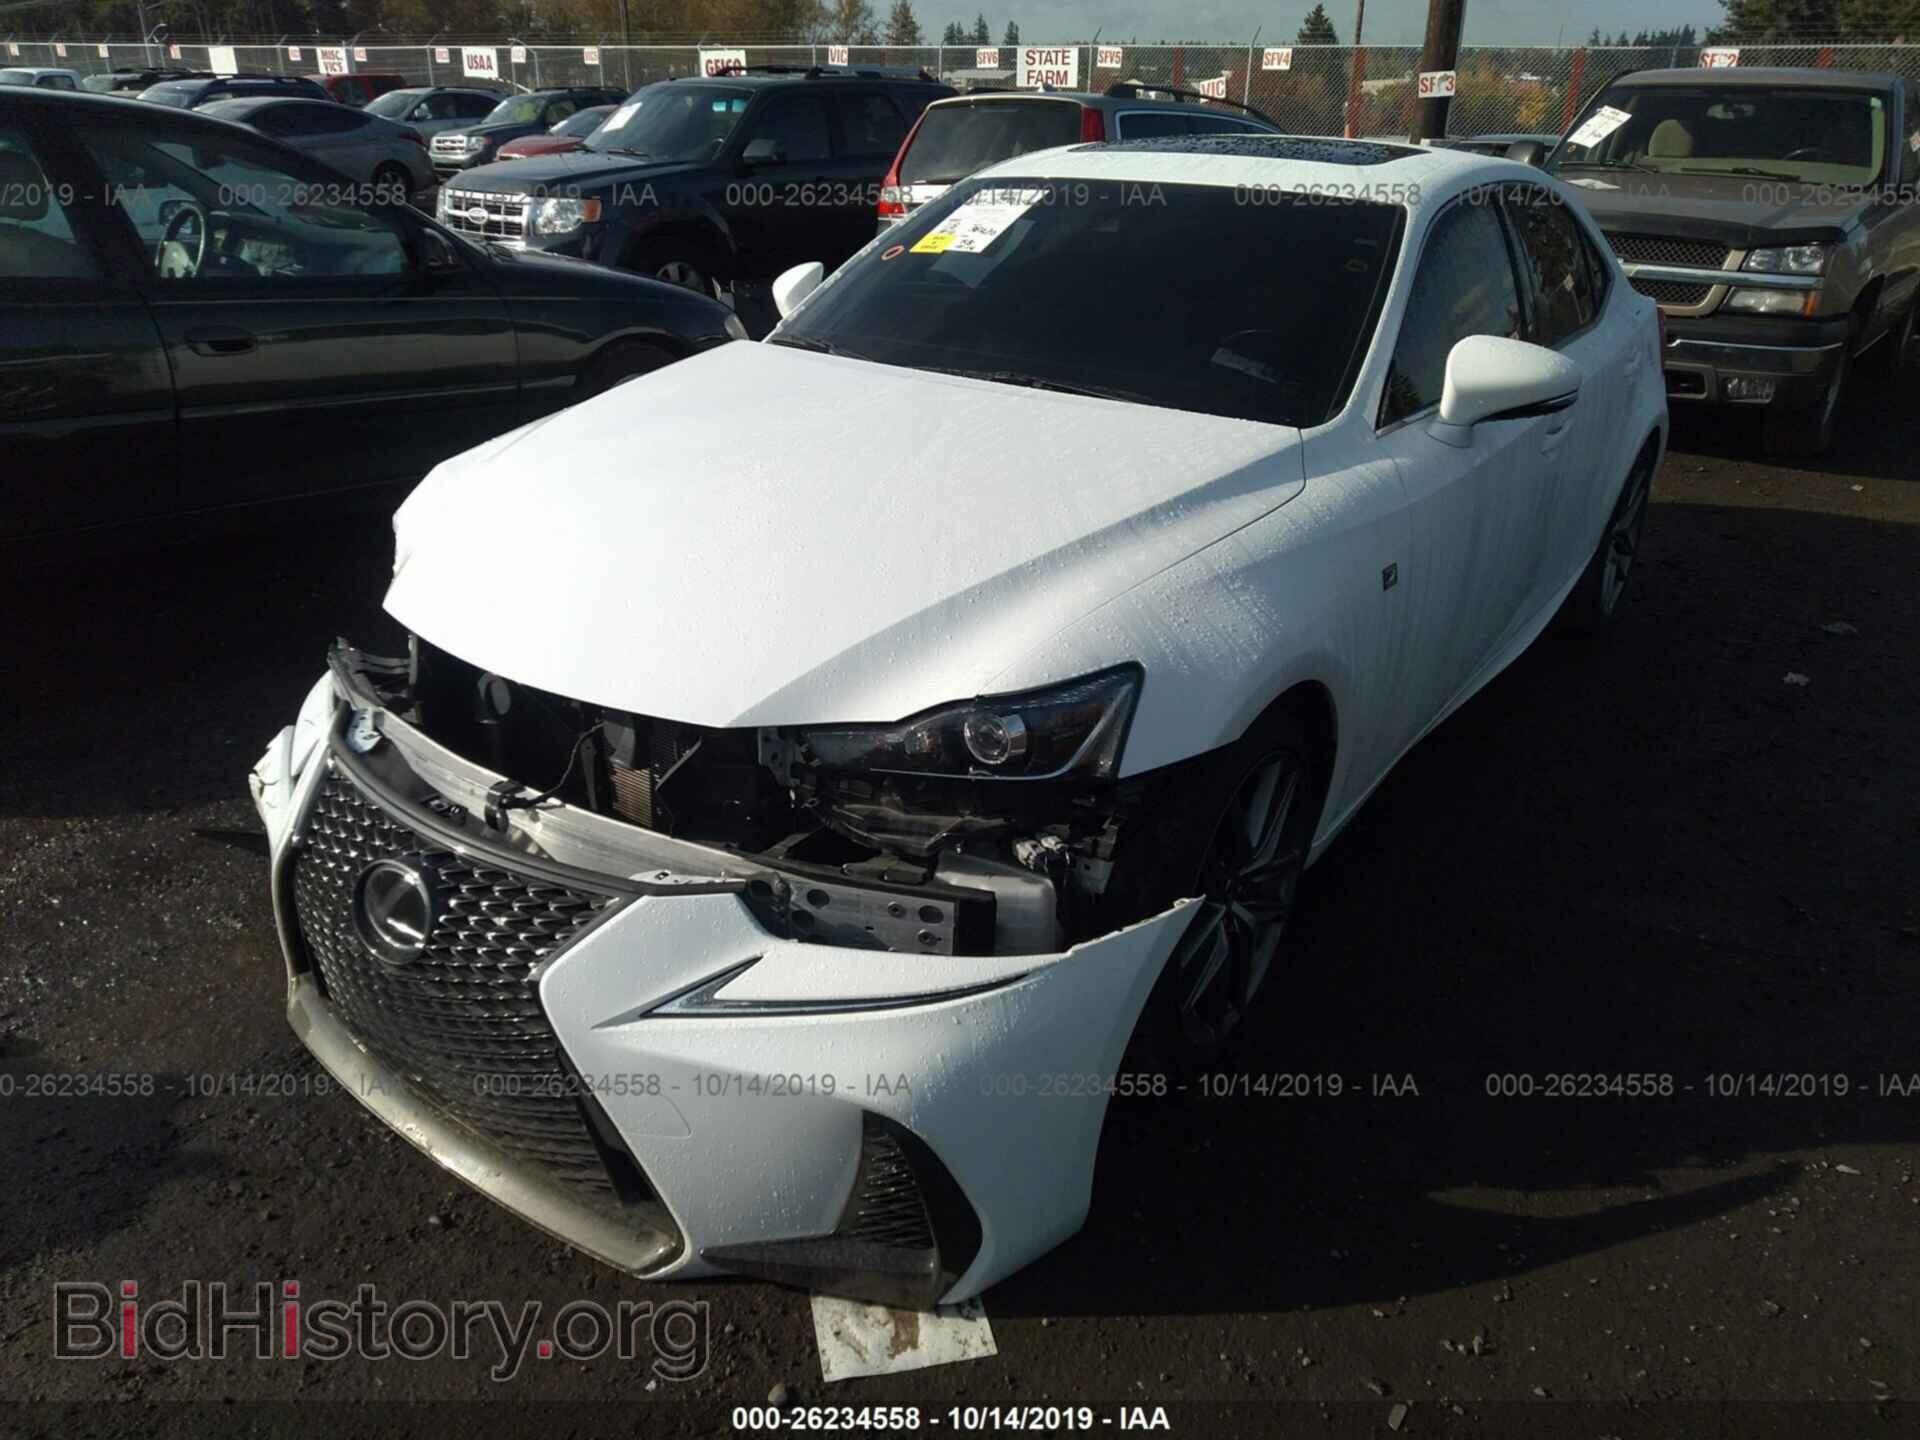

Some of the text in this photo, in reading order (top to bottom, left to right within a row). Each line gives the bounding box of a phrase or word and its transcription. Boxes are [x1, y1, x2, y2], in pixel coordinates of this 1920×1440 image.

[466, 54, 493, 70] USAA
[976, 51, 998, 64] SFV6
[1025, 50, 1071, 65] STATE
[1099, 51, 1121, 64] SFV5
[1263, 51, 1290, 66] SFV4
[1026, 70, 1068, 85] FARM
[1420, 76, 1455, 93] SF3
